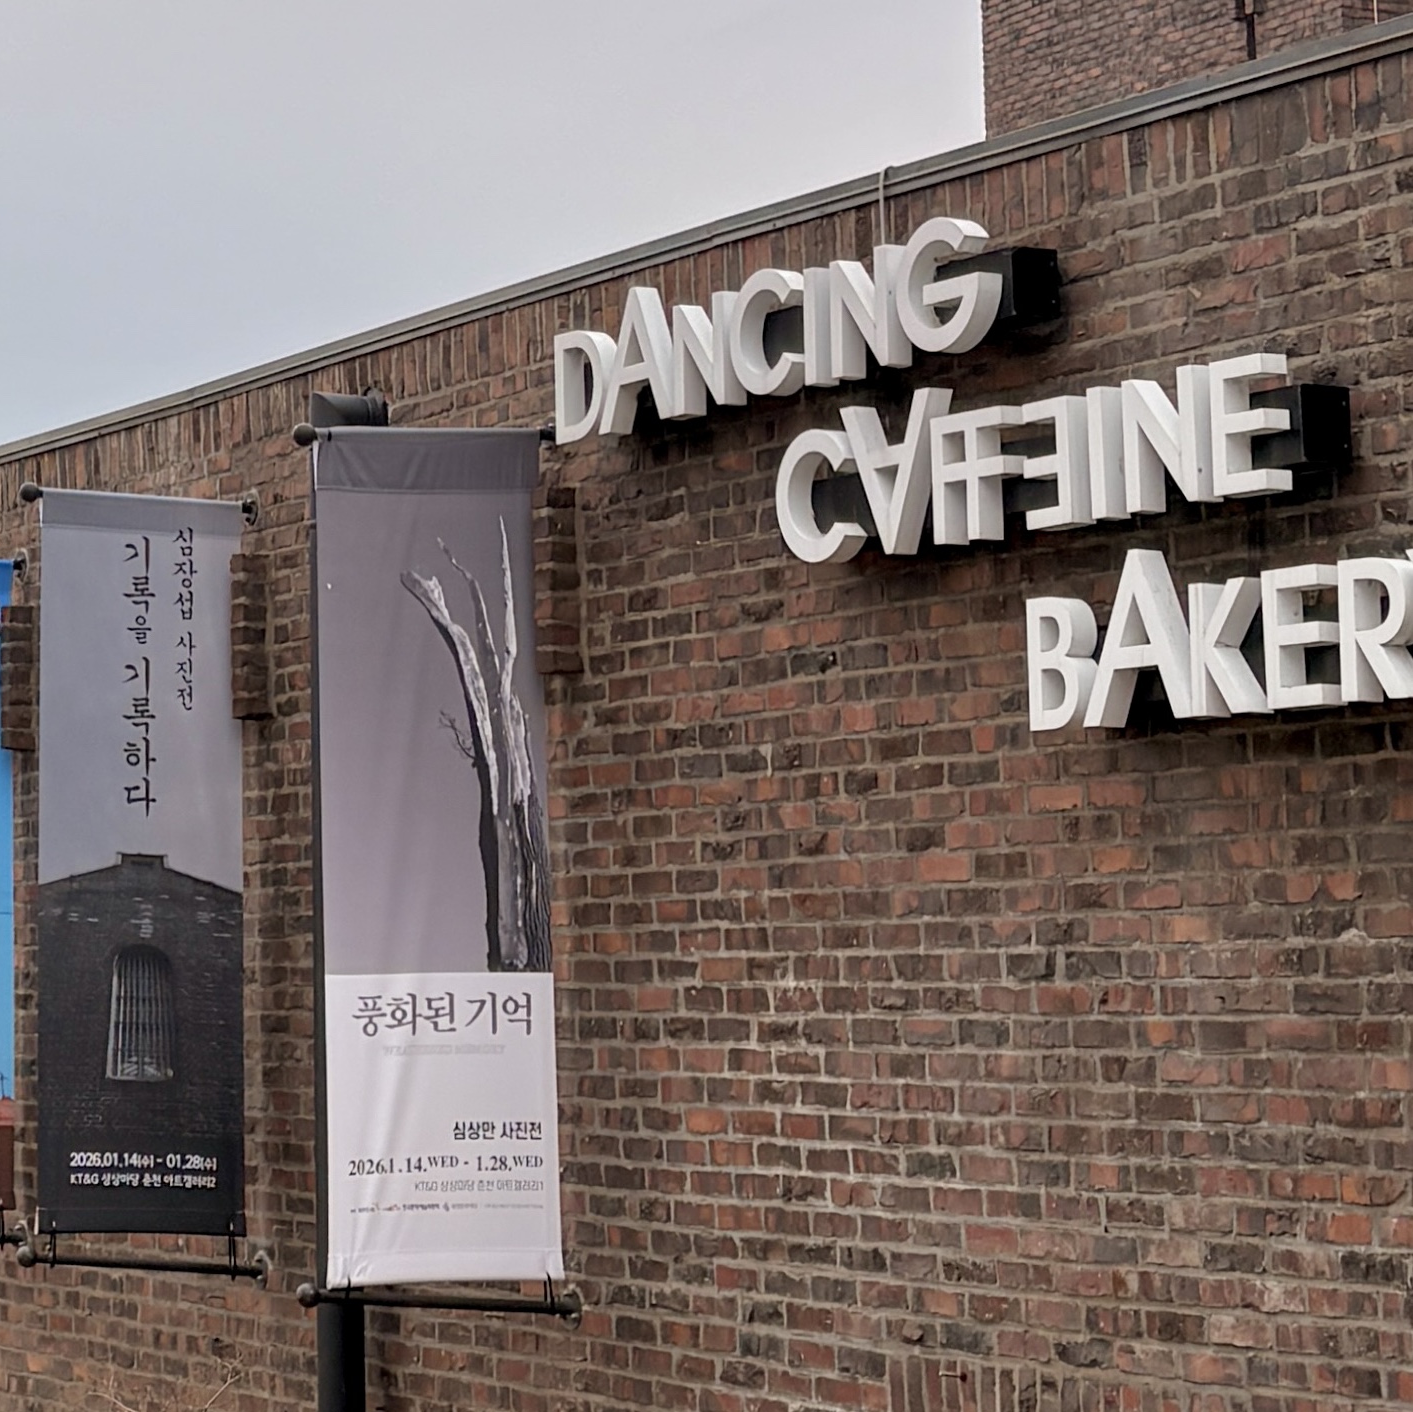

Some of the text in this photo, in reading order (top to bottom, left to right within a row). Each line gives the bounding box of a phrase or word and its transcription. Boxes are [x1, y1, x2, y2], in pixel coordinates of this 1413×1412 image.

[554, 217, 1002, 445] DANCING
[776, 353, 1293, 563] CAFFEINE
[175, 631, 196, 710] 사진전
[1027, 549, 1413, 731] BAKER
[122, 536, 156, 818] 기록을 기록하다
[352, 991, 532, 1037] 풍화된 기억
[69, 1152, 154, 1169] 2026.01.14(수)
[166, 1154, 217, 1171] 01.28(수)
[453, 1121, 542, 1140] 심상만 사진전
[70, 1173, 99, 1185] KT&G
[414, 1180, 438, 1192] KT&G
